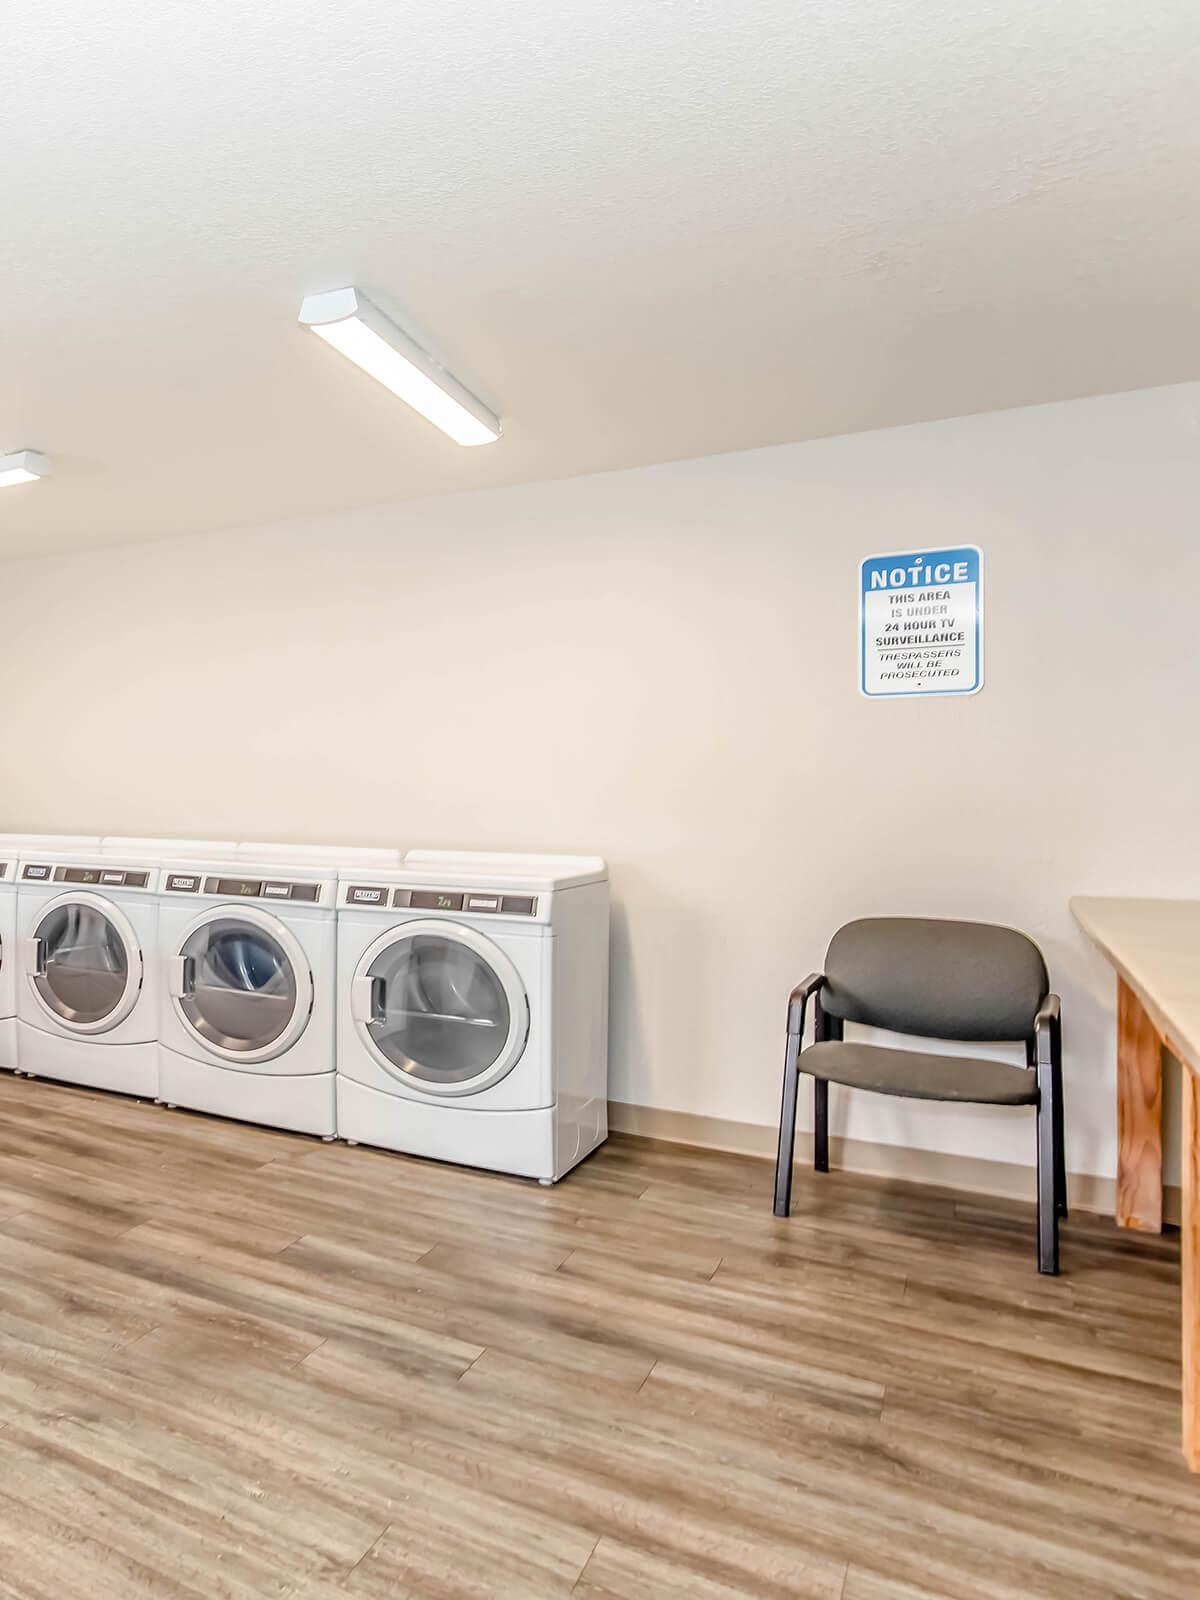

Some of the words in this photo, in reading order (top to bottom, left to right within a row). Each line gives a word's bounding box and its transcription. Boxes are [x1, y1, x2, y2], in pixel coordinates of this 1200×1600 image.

[871, 562, 969, 589] NOTICE
[888, 593, 915, 605] THIS
[918, 590, 951, 602] AREA
[891, 607, 903, 618] IS
[906, 604, 948, 617] UNDER
[884, 622, 899, 632] 24
[903, 619, 937, 631] HOUR
[941, 618, 956, 628] TV
[875, 631, 965, 647] SURVEILLANCE
[879, 648, 961, 662] TRESPASSERS
[896, 661, 922, 670] WILL
[926, 659, 943, 668] BE
[879, 668, 960, 680] PROSECUTED
